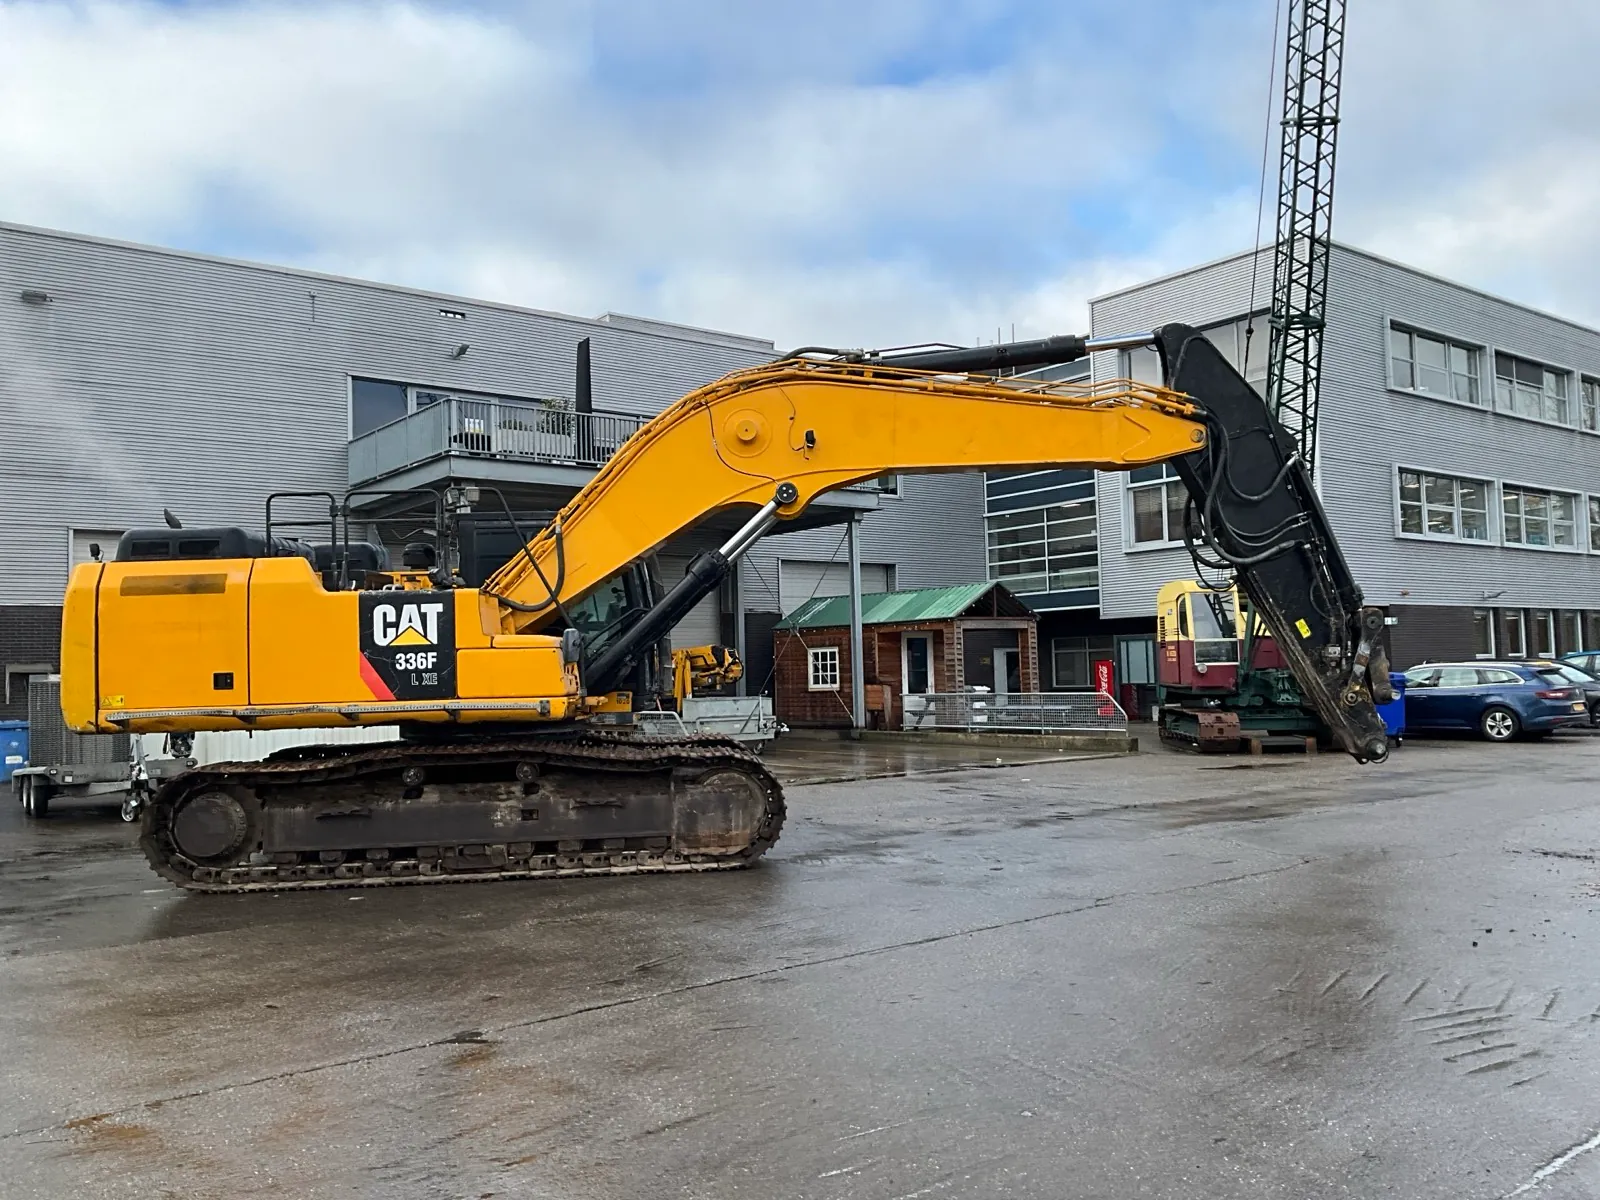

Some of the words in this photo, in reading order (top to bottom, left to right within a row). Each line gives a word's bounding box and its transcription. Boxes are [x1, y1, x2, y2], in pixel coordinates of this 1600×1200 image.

[373, 603, 443, 646] CAT
[395, 652, 438, 670] 336F
[411, 673, 419, 685] L
[422, 673, 438, 685] XE
